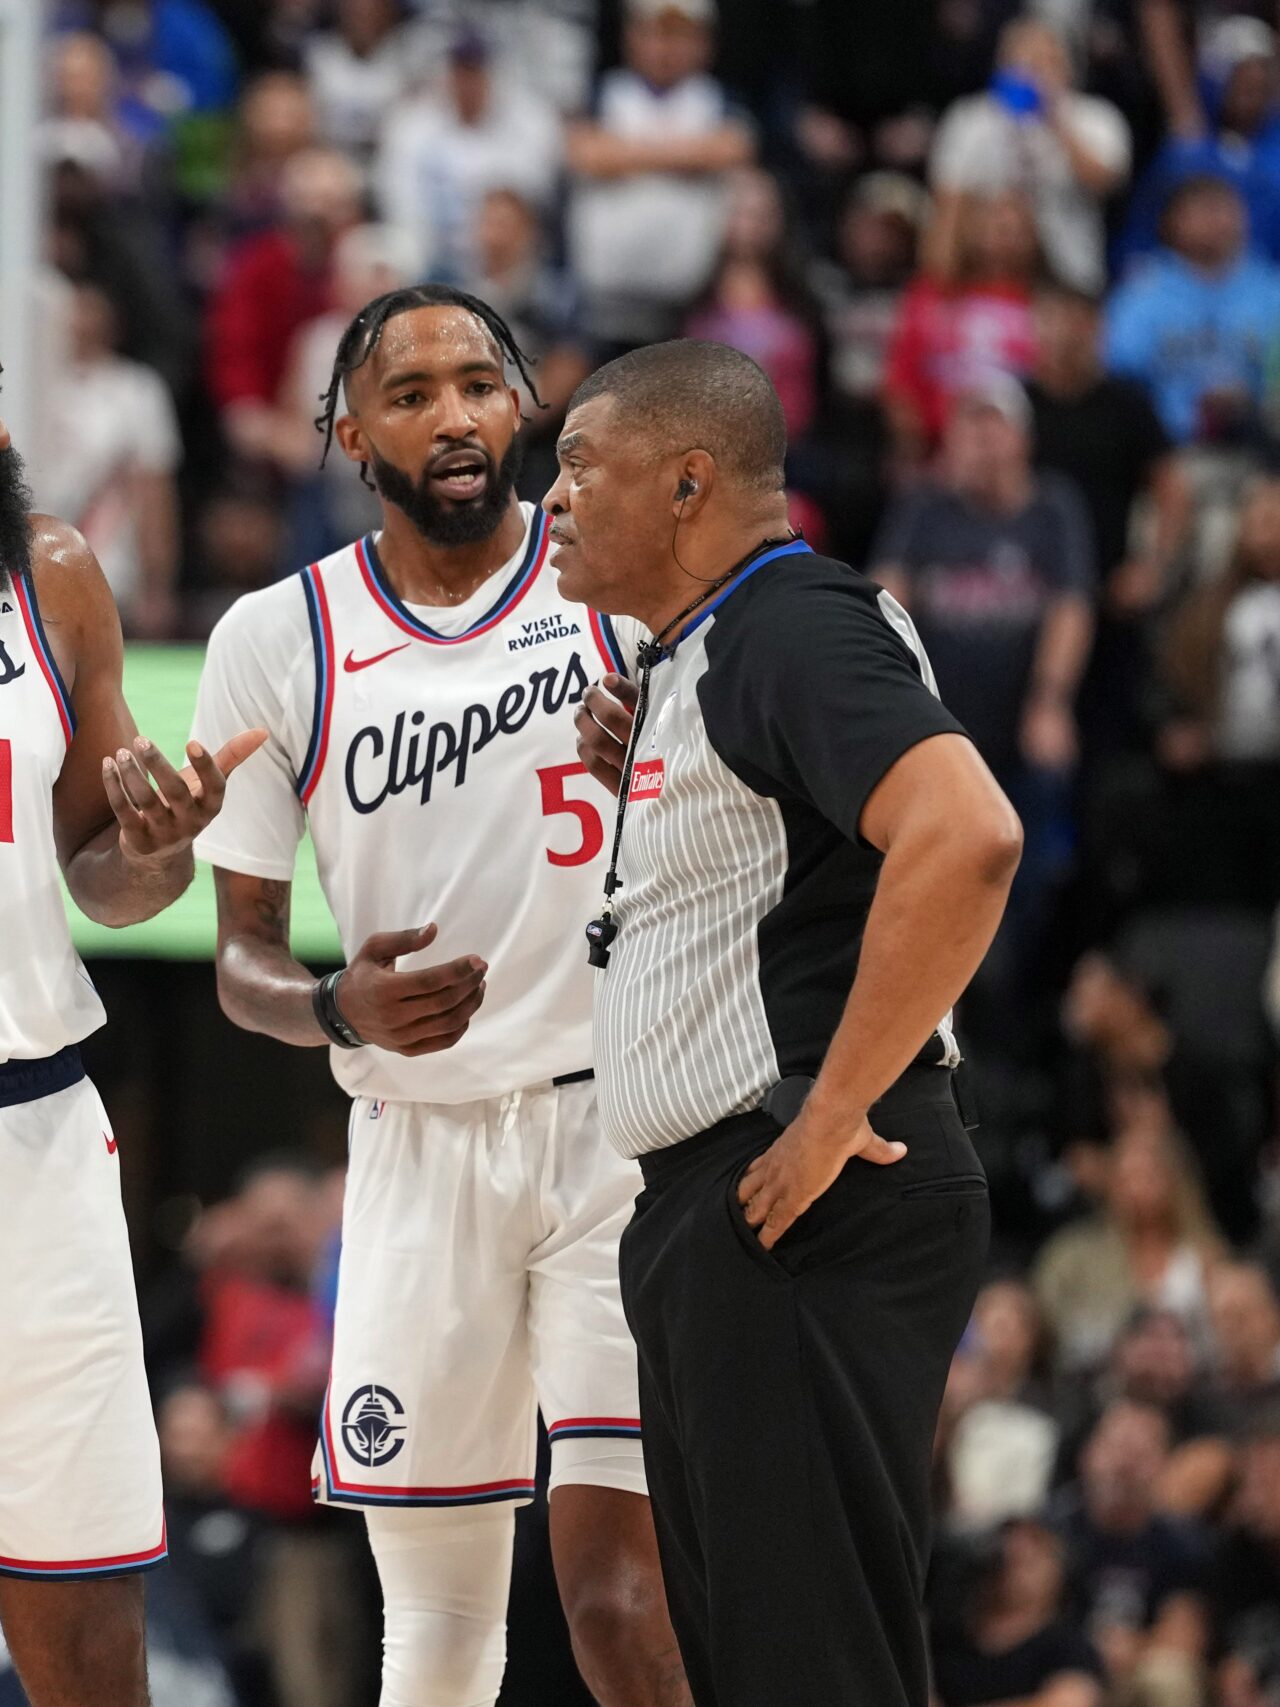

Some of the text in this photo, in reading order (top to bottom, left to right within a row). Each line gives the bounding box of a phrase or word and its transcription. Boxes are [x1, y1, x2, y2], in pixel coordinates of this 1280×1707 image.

[507, 623, 581, 652] RWANDA
[521, 613, 563, 634] VISIT
[344, 651, 600, 815] Clippers
[631, 768, 664, 793] Emirates
[535, 761, 605, 868] 5
